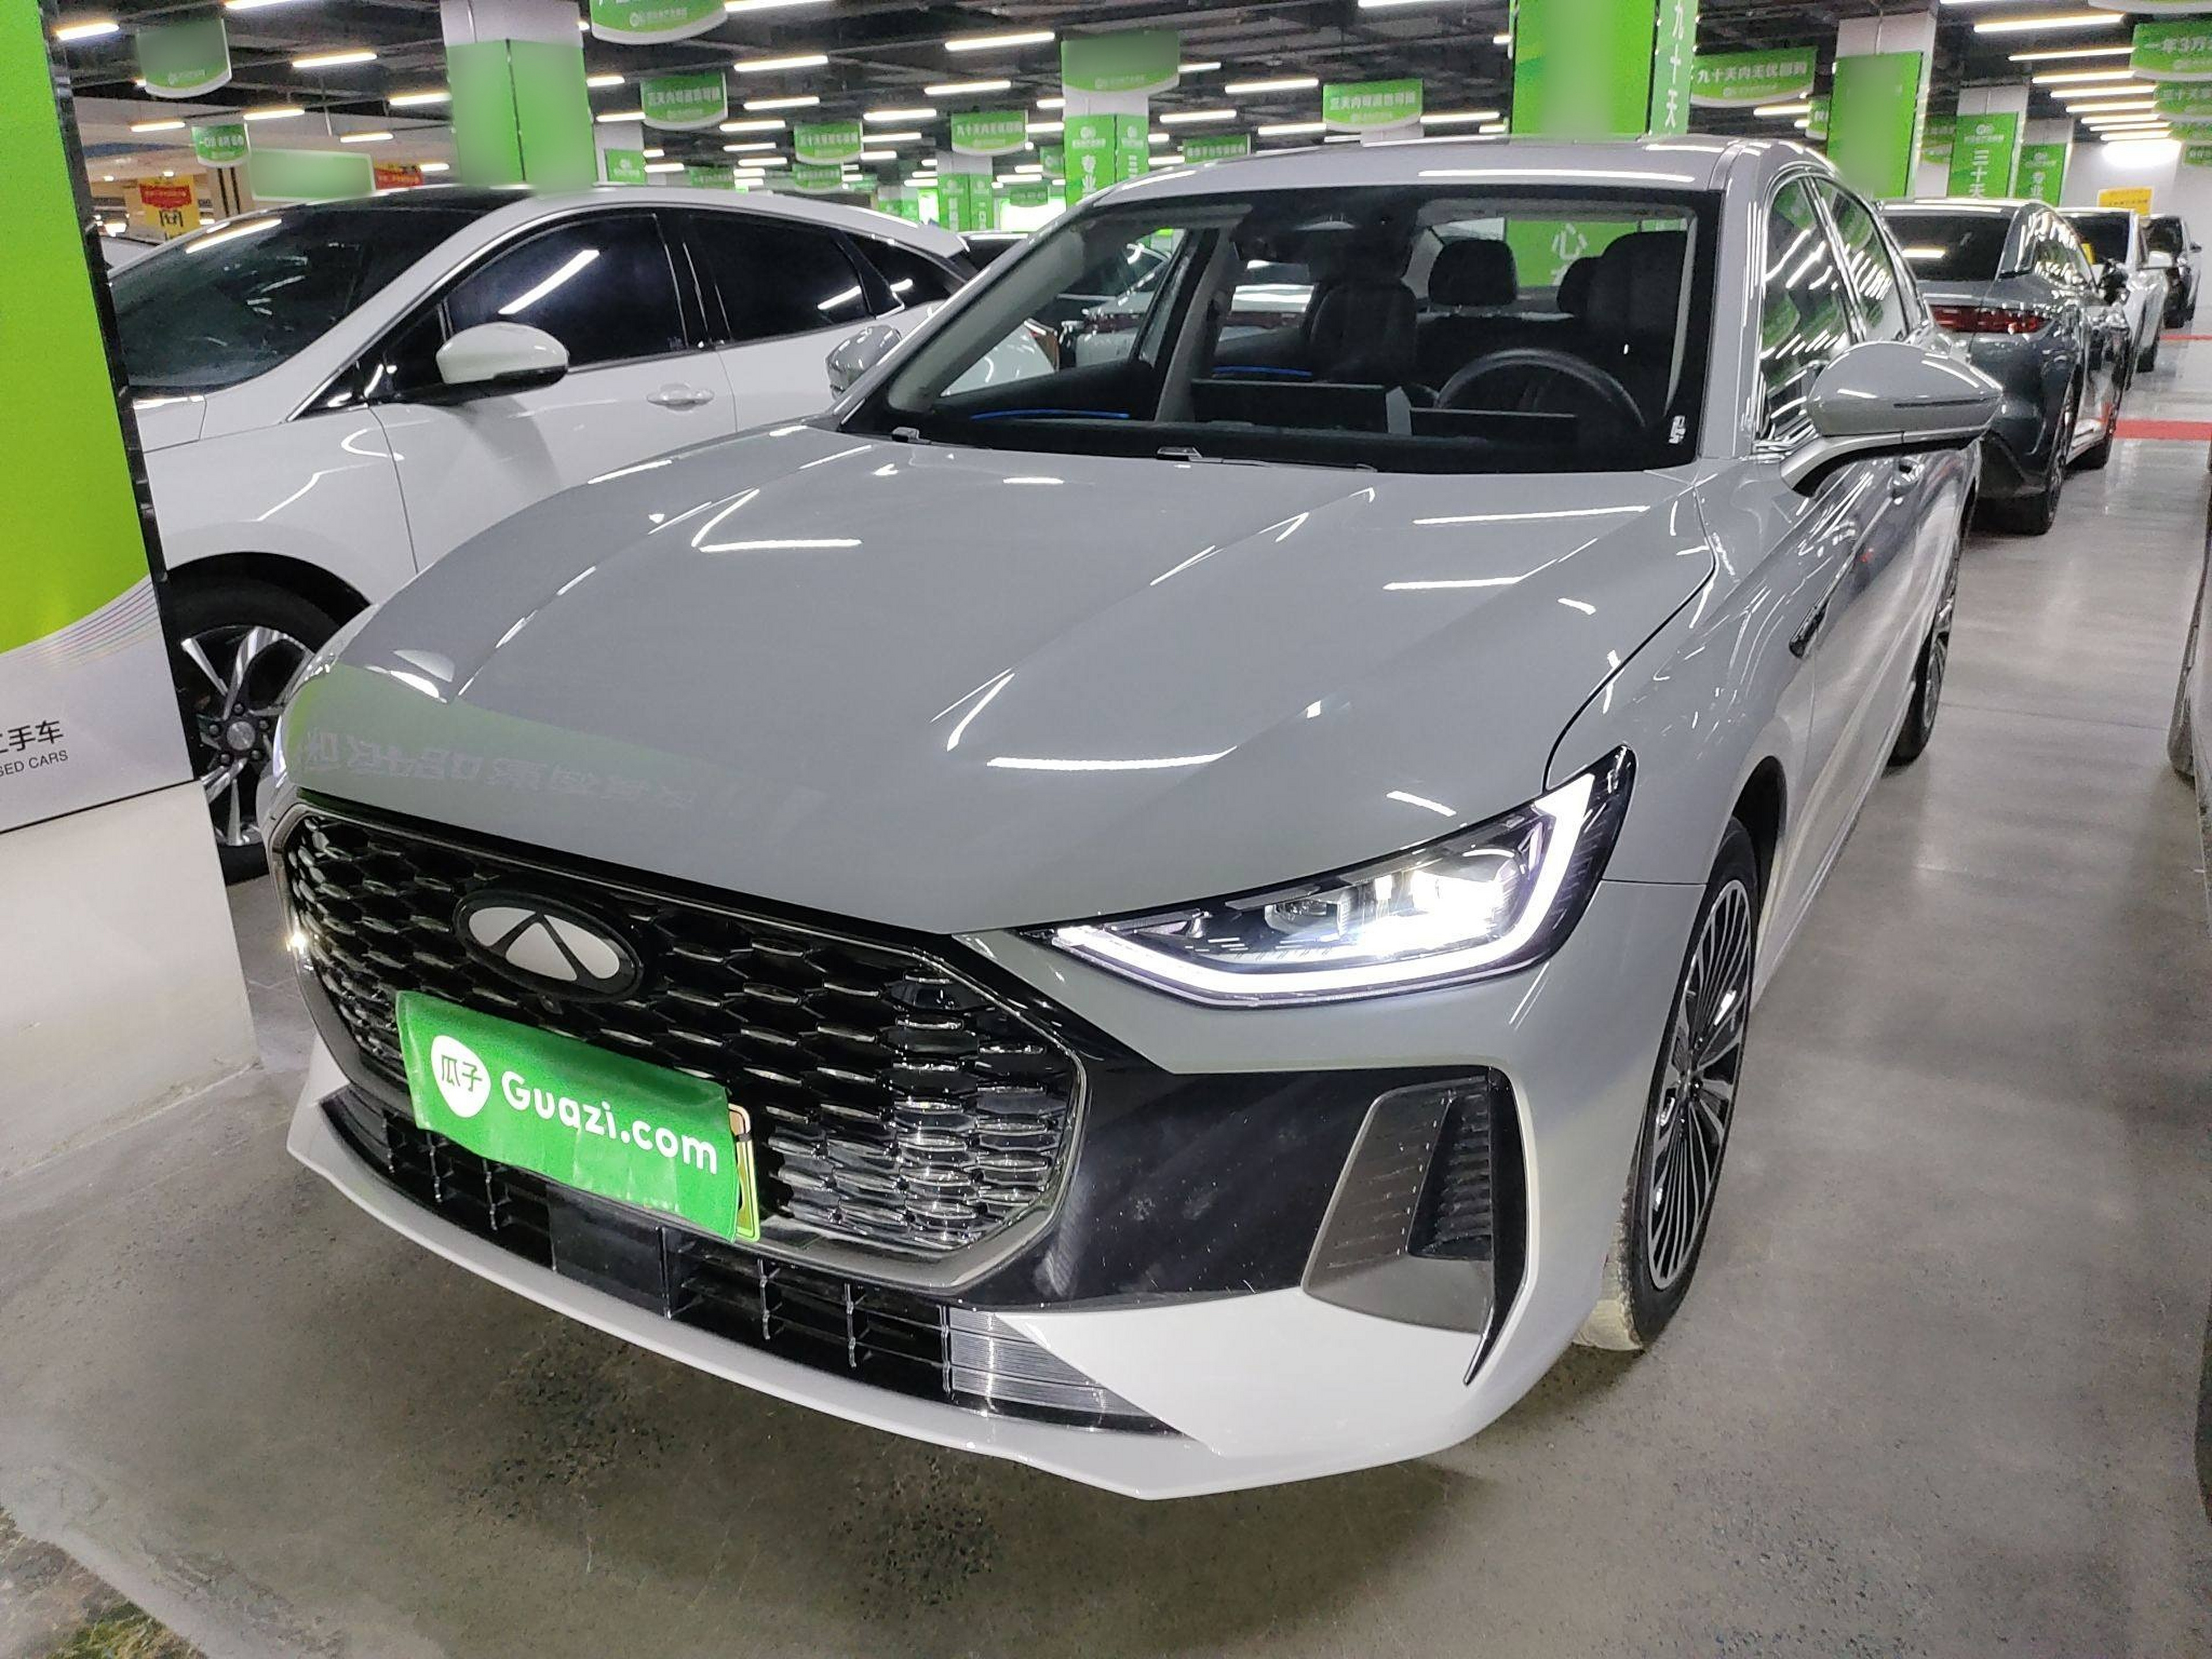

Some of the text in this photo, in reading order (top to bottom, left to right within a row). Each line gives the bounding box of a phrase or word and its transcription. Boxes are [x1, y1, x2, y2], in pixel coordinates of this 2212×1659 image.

[29, 750, 69, 768] CARS
[441, 1054, 483, 1092] 瓜子
[501, 1070, 718, 1175] Guazi.com
